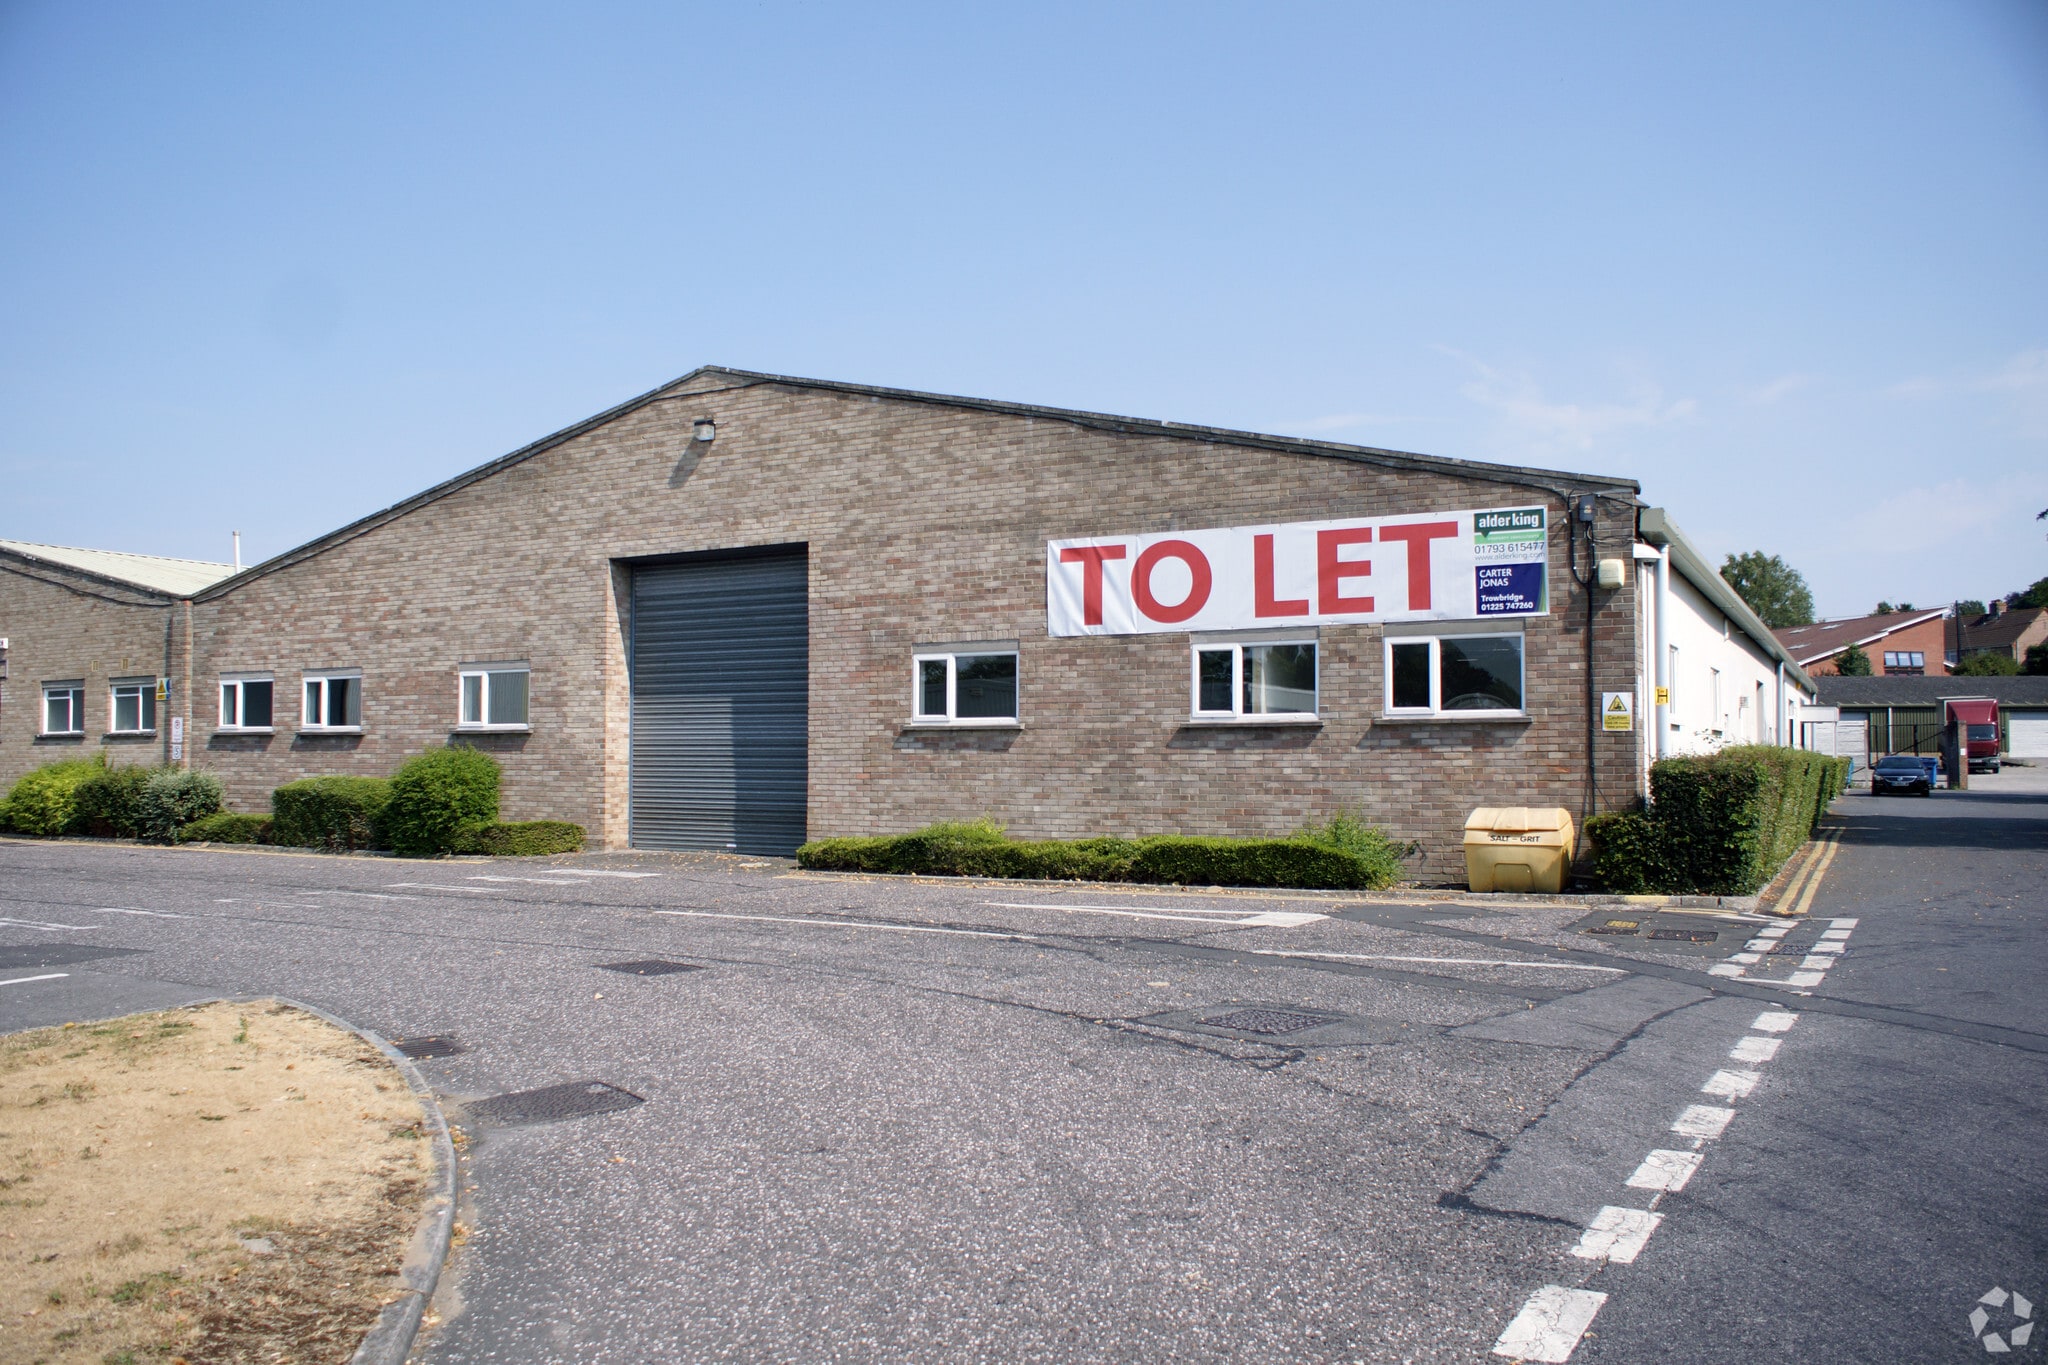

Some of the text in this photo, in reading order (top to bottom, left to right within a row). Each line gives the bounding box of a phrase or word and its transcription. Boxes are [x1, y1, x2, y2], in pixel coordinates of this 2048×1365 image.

[1478, 512, 1539, 528] alder king
[1474, 541, 1545, 554] 01793 615477
[1060, 521, 1459, 625] TO LET
[1479, 568, 1512, 578] CARTER
[1479, 578, 1509, 589] JONAS
[1480, 593, 1524, 602] Trowbridge
[1481, 601, 1534, 611] 01225 747260
